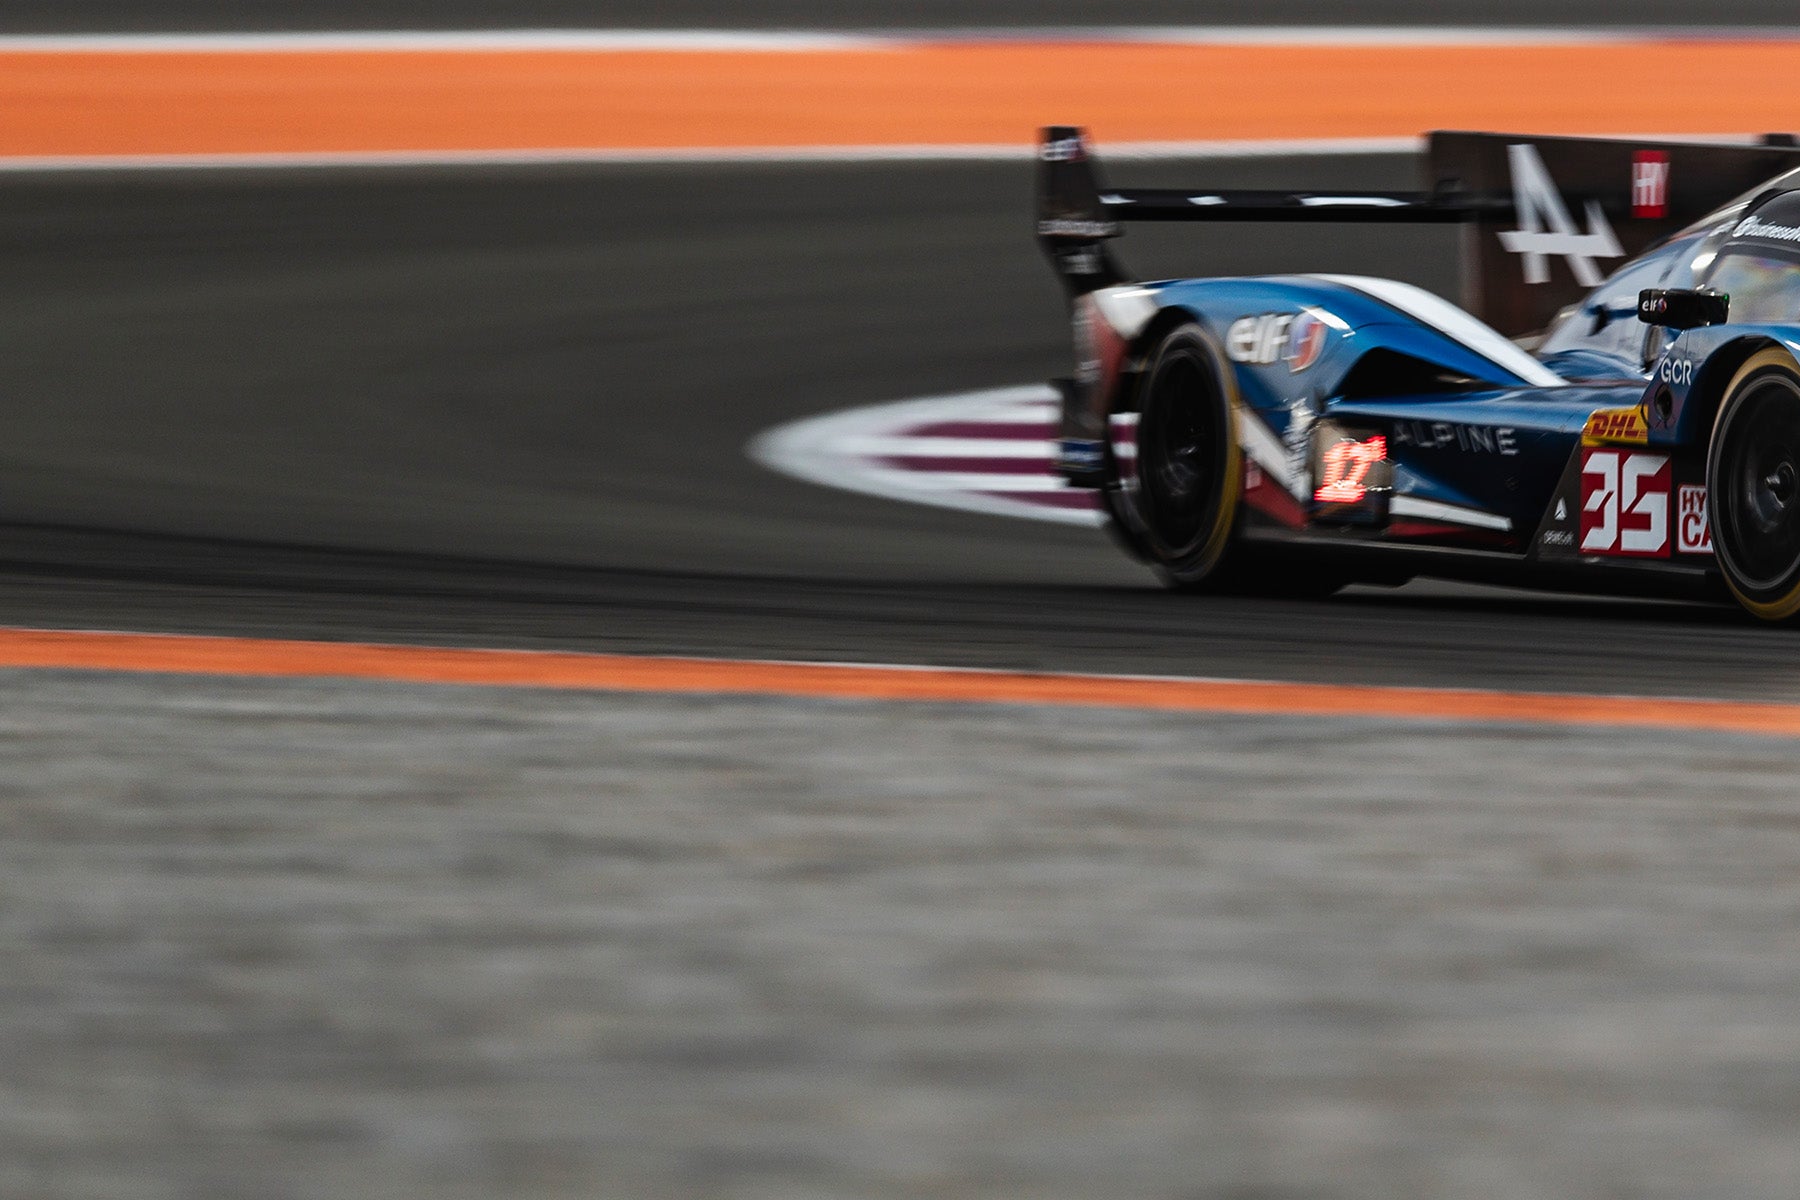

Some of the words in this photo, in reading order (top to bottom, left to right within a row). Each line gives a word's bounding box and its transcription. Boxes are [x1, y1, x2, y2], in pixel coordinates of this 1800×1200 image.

[1642, 300, 1657, 312] elf
[1226, 313, 1293, 363] elf
[1660, 357, 1693, 386] GCR
[1392, 421, 1520, 455] ALPINE
[1591, 414, 1640, 437] DHL
[1580, 452, 1671, 552] 35
